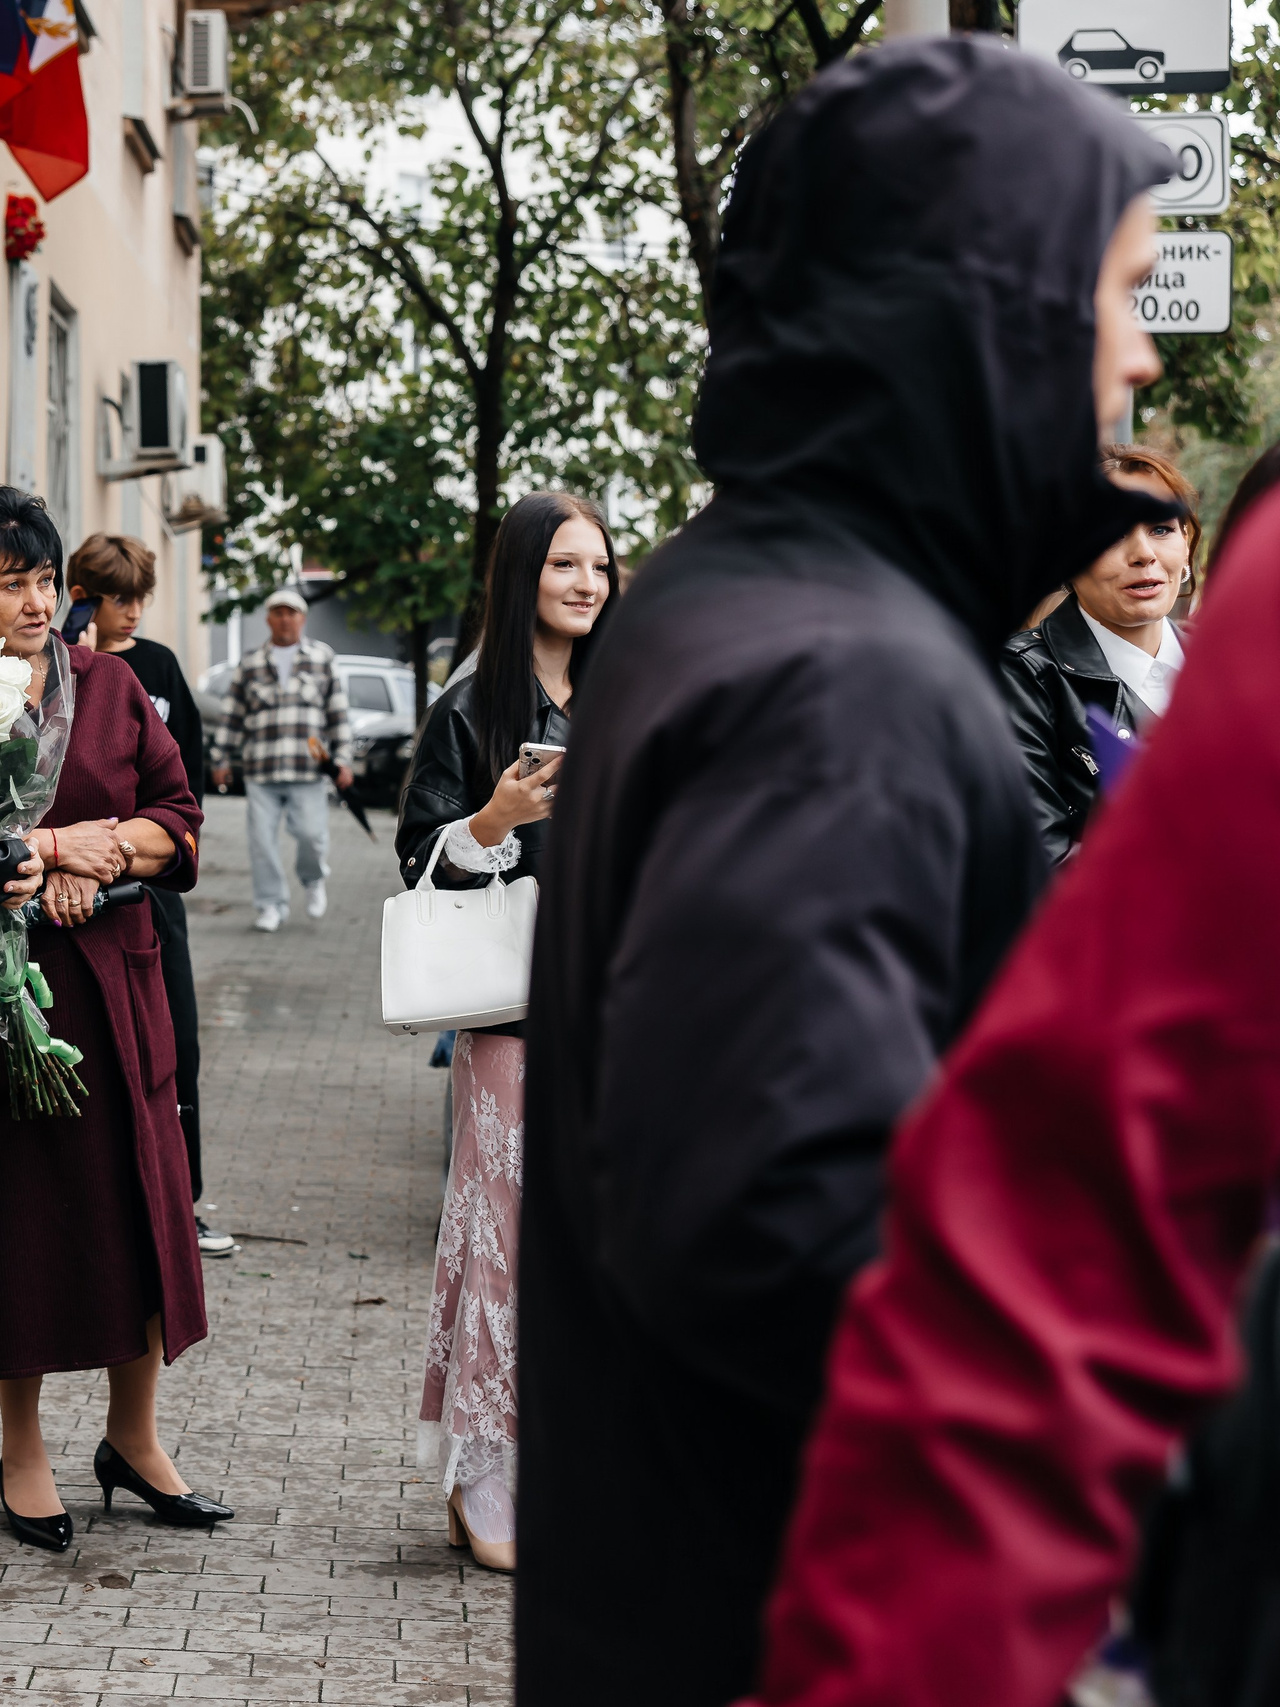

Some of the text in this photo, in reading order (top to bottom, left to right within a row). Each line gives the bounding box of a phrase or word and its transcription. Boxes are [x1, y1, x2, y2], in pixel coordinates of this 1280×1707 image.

[1177, 144, 1203, 182] 0
[1155, 244, 1222, 262] ник-
[1132, 271, 1187, 291] ица
